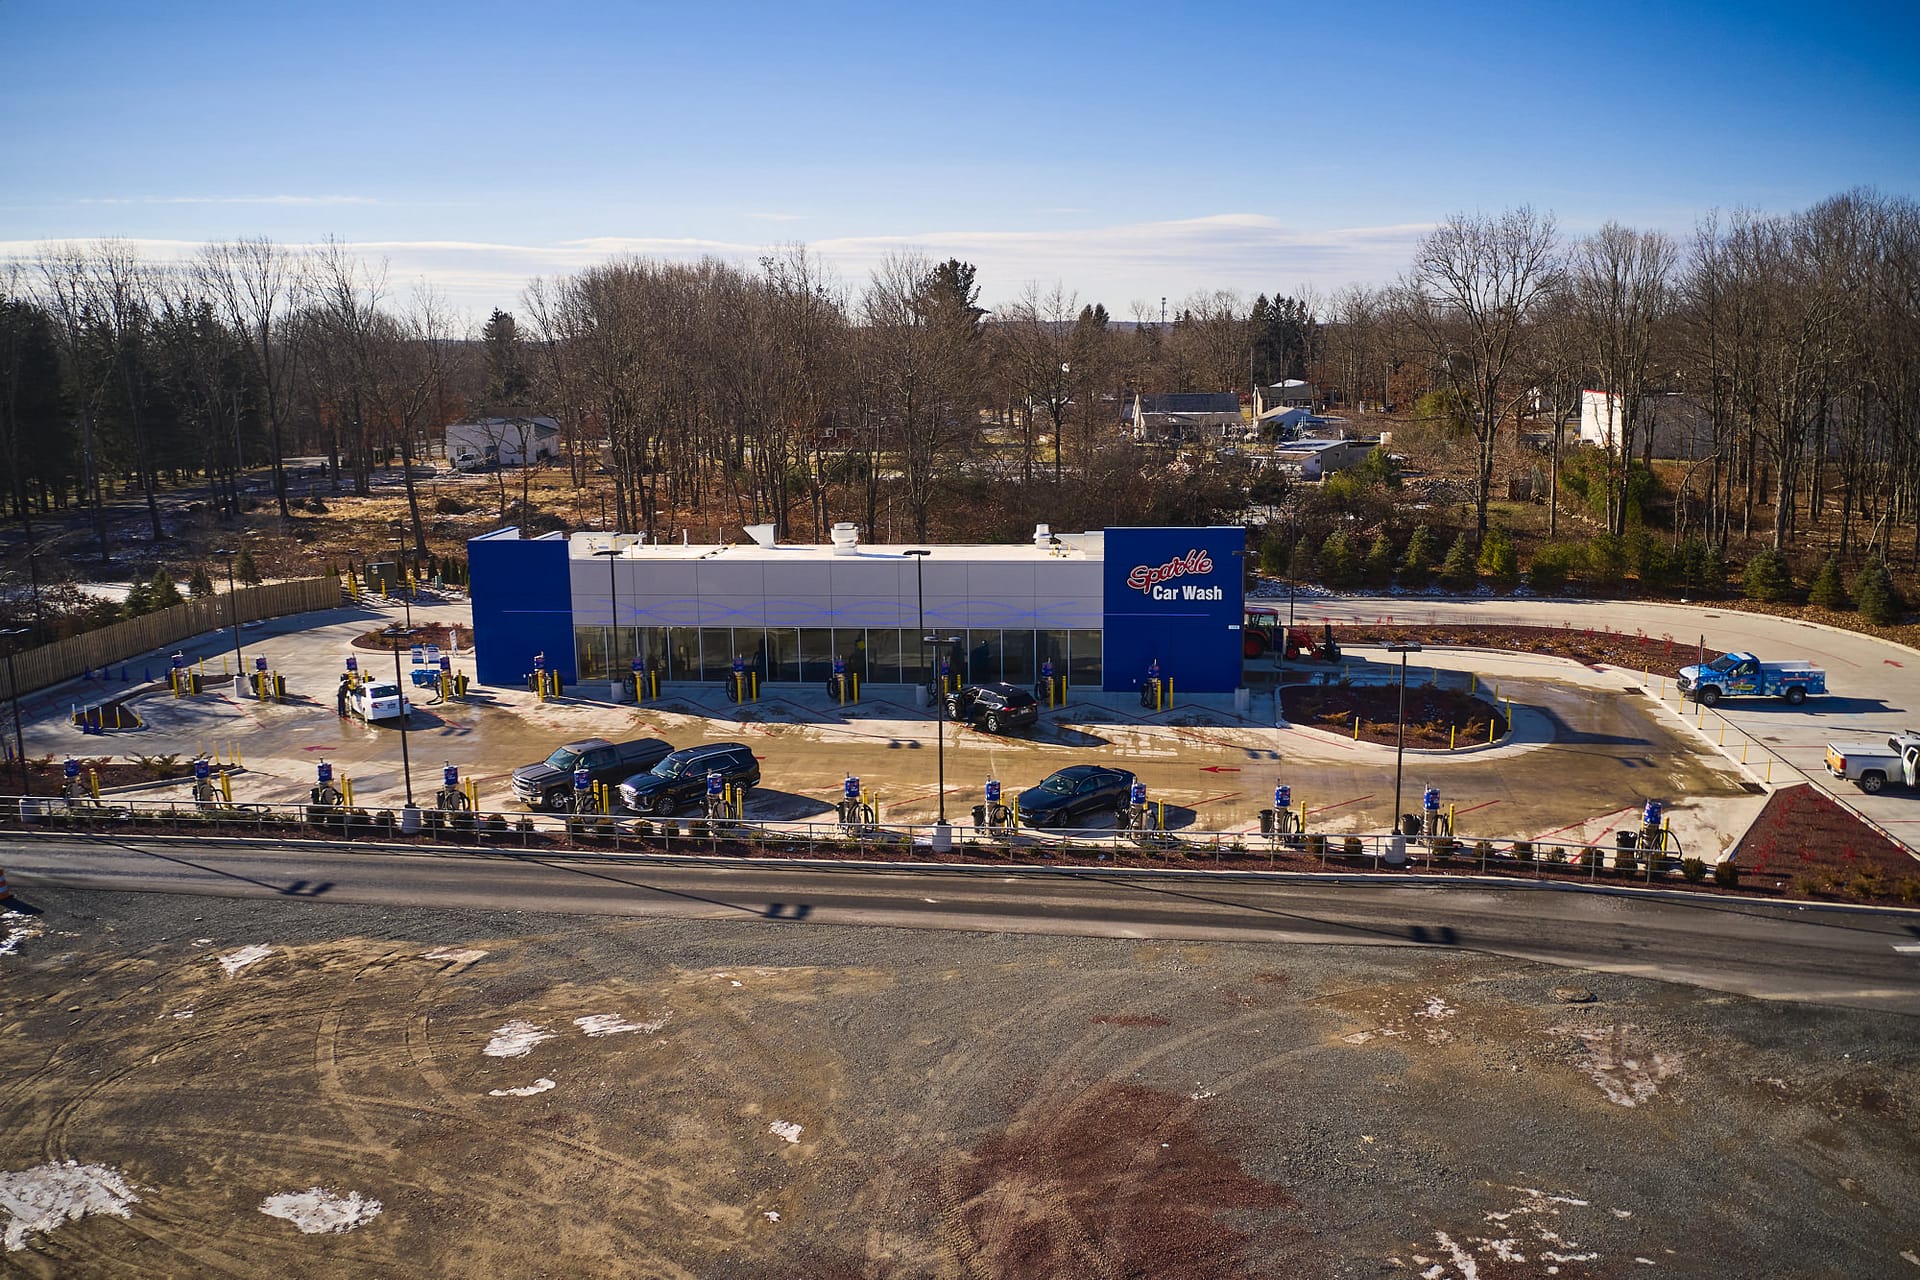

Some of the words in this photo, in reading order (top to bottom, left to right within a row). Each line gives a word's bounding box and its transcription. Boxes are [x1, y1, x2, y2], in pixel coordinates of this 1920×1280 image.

[1127, 549, 1213, 594] Sparkle
[1153, 585, 1178, 600] Car
[1182, 585, 1222, 600] Wash
